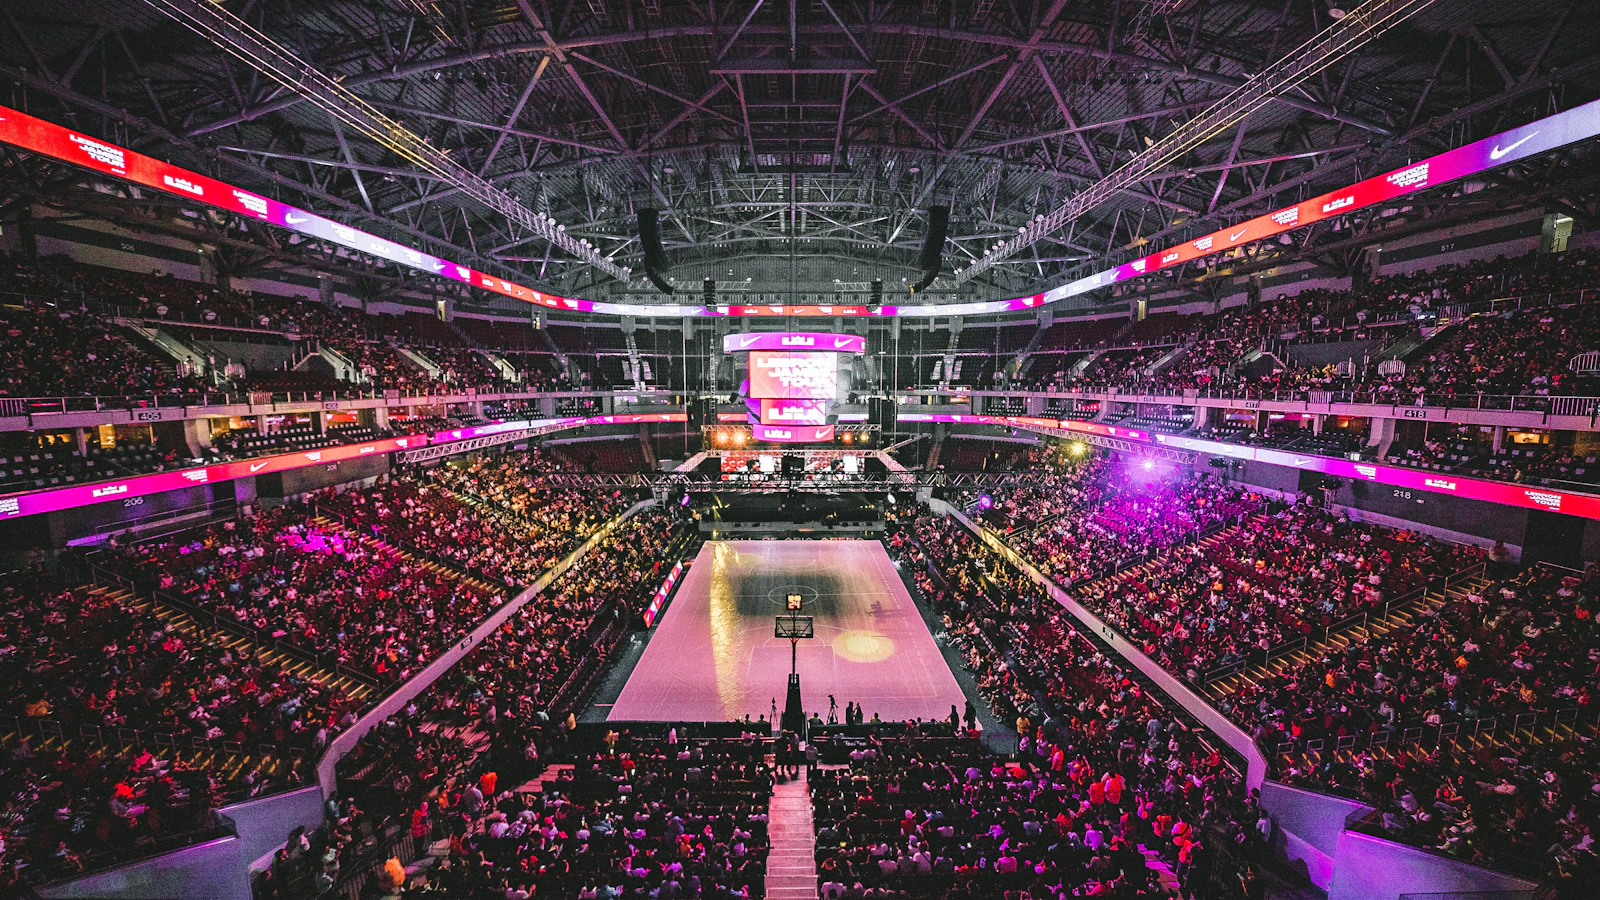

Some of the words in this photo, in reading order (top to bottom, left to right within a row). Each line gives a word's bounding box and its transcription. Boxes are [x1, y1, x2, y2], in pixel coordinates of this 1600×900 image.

[1387, 163, 1429, 182] LEBRON
[1392, 169, 1428, 184] JAMES
[1399, 174, 1428, 187] TOUR
[1441, 243, 1455, 252] 517
[757, 358, 831, 368] LEBRON
[779, 377, 830, 387] TOUR
[140, 412, 160, 420] 405
[1406, 410, 1425, 418] 418
[1393, 489, 1412, 499] 218
[1524, 490, 1562, 500] LEBRON
[1530, 495, 1561, 503] JAMES
[124, 496, 144, 507] 205
[1535, 499, 1561, 507] TOUR
